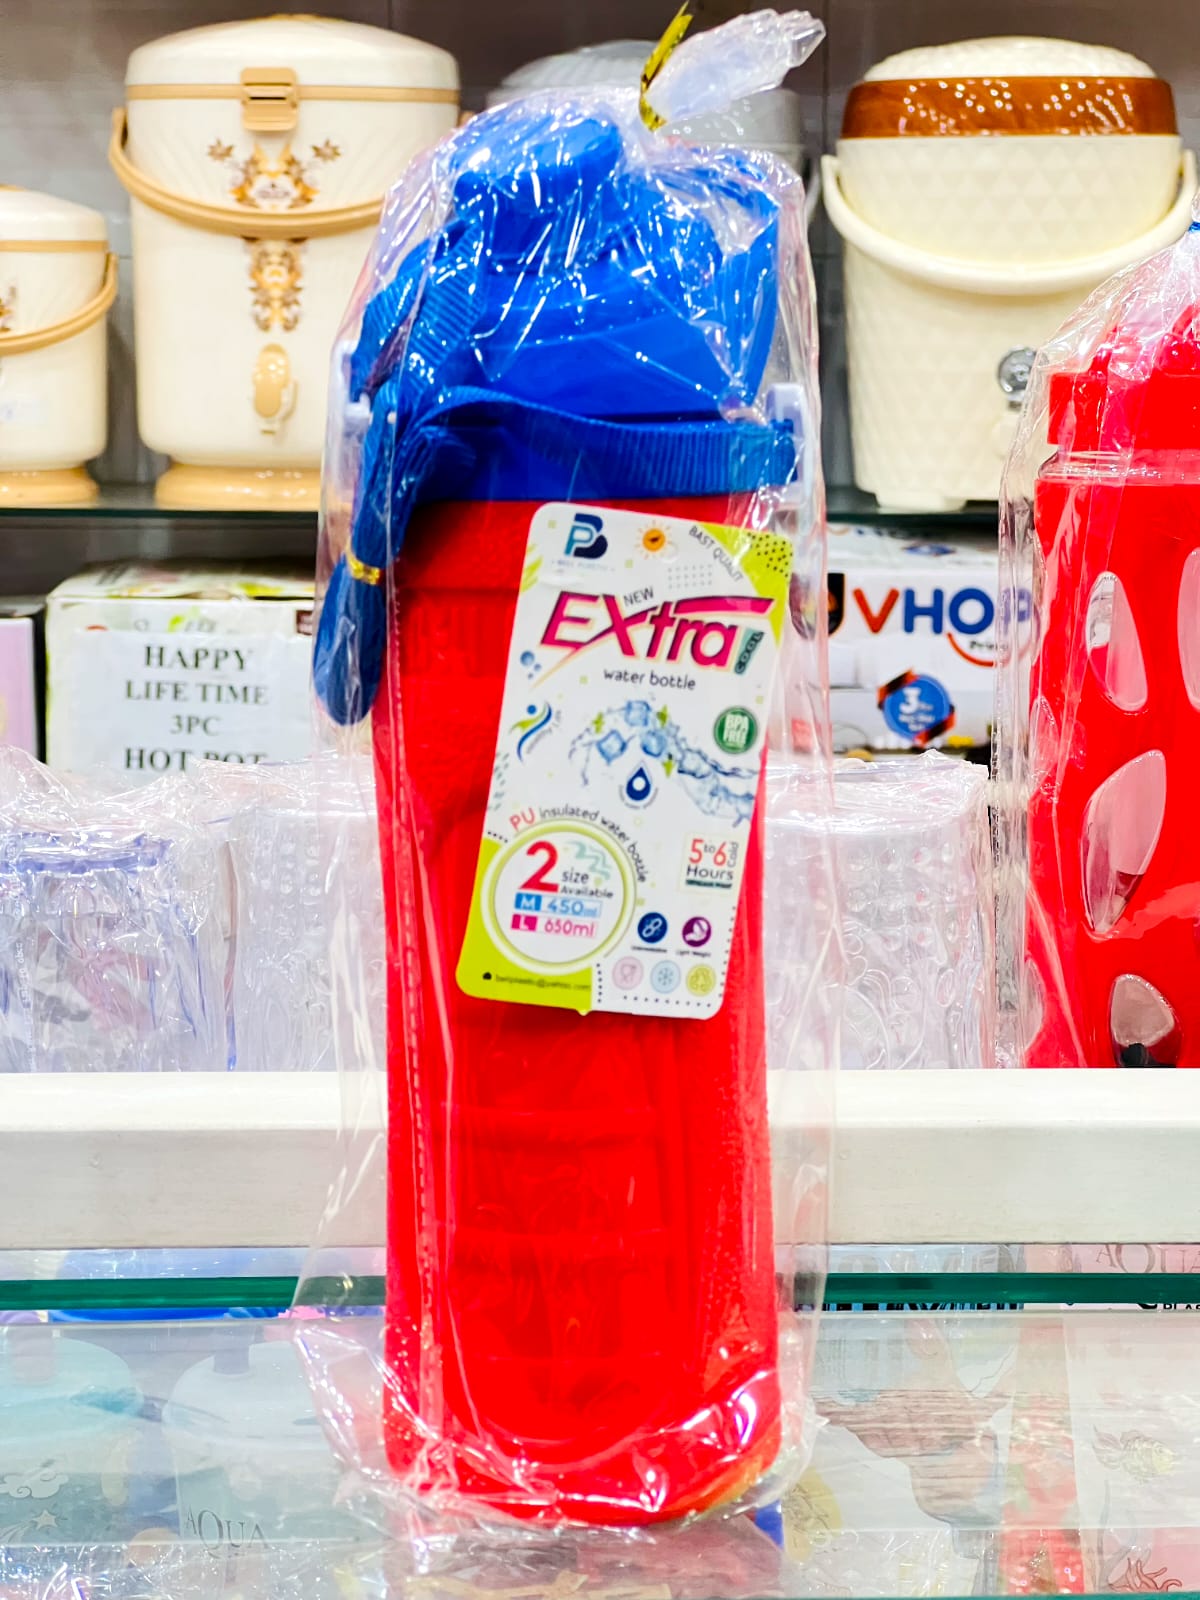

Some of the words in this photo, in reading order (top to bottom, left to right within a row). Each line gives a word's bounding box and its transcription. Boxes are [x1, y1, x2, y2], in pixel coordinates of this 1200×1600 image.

[623, 587, 654, 606] NEW
[145, 646, 251, 671] HAPPY
[604, 669, 645, 685] water
[650, 670, 696, 690] bottle
[125, 680, 188, 701] LIFE
[197, 683, 269, 705] TIME
[170, 715, 221, 736] 3PC
[125, 748, 193, 772] HOT
[509, 807, 536, 832] PU
[539, 803, 599, 820] insulated
[601, 817, 630, 841] water
[627, 840, 648, 883] bottle
[688, 838, 704, 864] 5
[713, 841, 727, 867] 6
[518, 840, 559, 893] 2
[561, 866, 589, 884] size
[686, 864, 734, 881] Hours
[520, 894, 536, 911] M
[560, 885, 614, 899] Available
[544, 918, 596, 938] 650ml
[185, 1506, 269, 1559] AQUA
